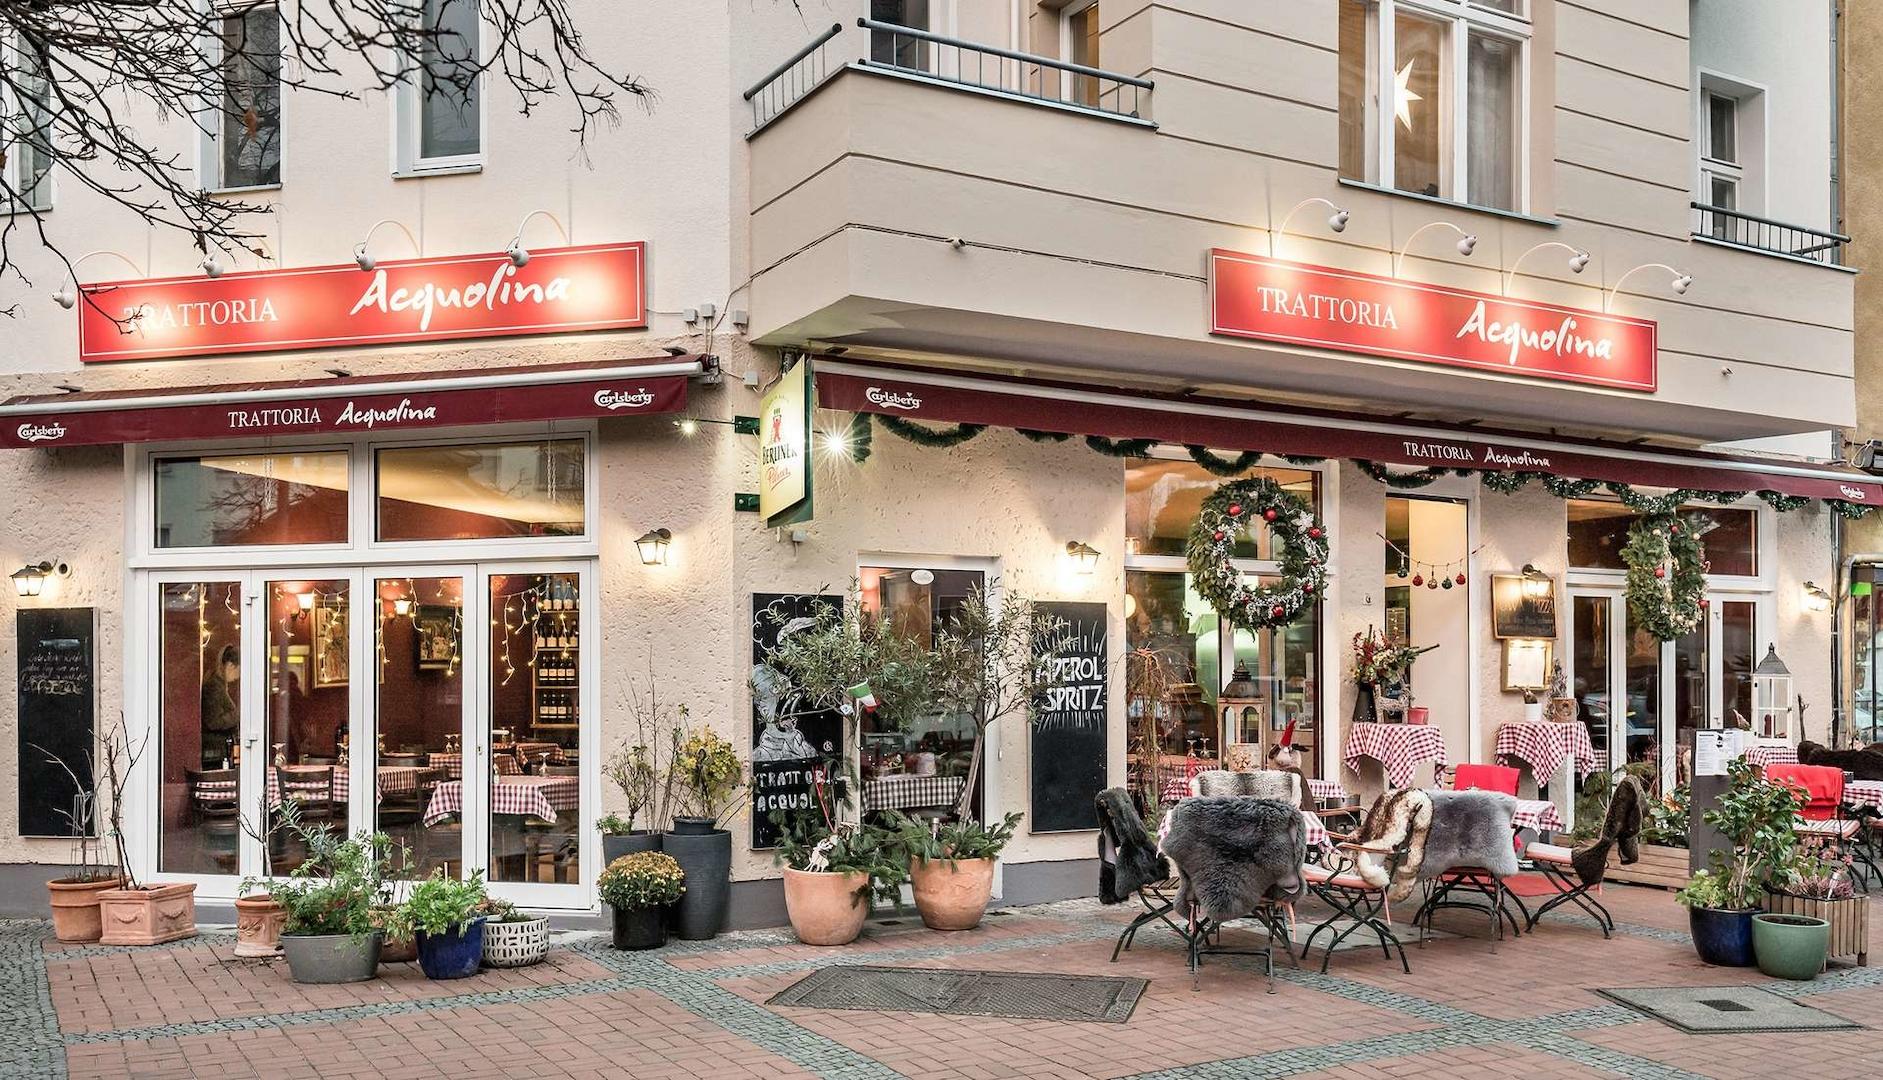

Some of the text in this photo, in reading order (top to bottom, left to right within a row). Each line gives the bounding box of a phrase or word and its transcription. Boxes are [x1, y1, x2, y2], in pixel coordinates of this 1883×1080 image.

[124, 262, 572, 332] TRATTORIA Acquolina
[1257, 286, 1613, 366] TRATTORIA Acquolina
[594, 388, 655, 410] Carlsberg
[866, 386, 922, 410] Carlsberg
[227, 398, 437, 429] TRATTORIA Acquolina
[17, 423, 67, 442] Carlsberg
[1403, 441, 1550, 469] TRATTORIA Acquolina
